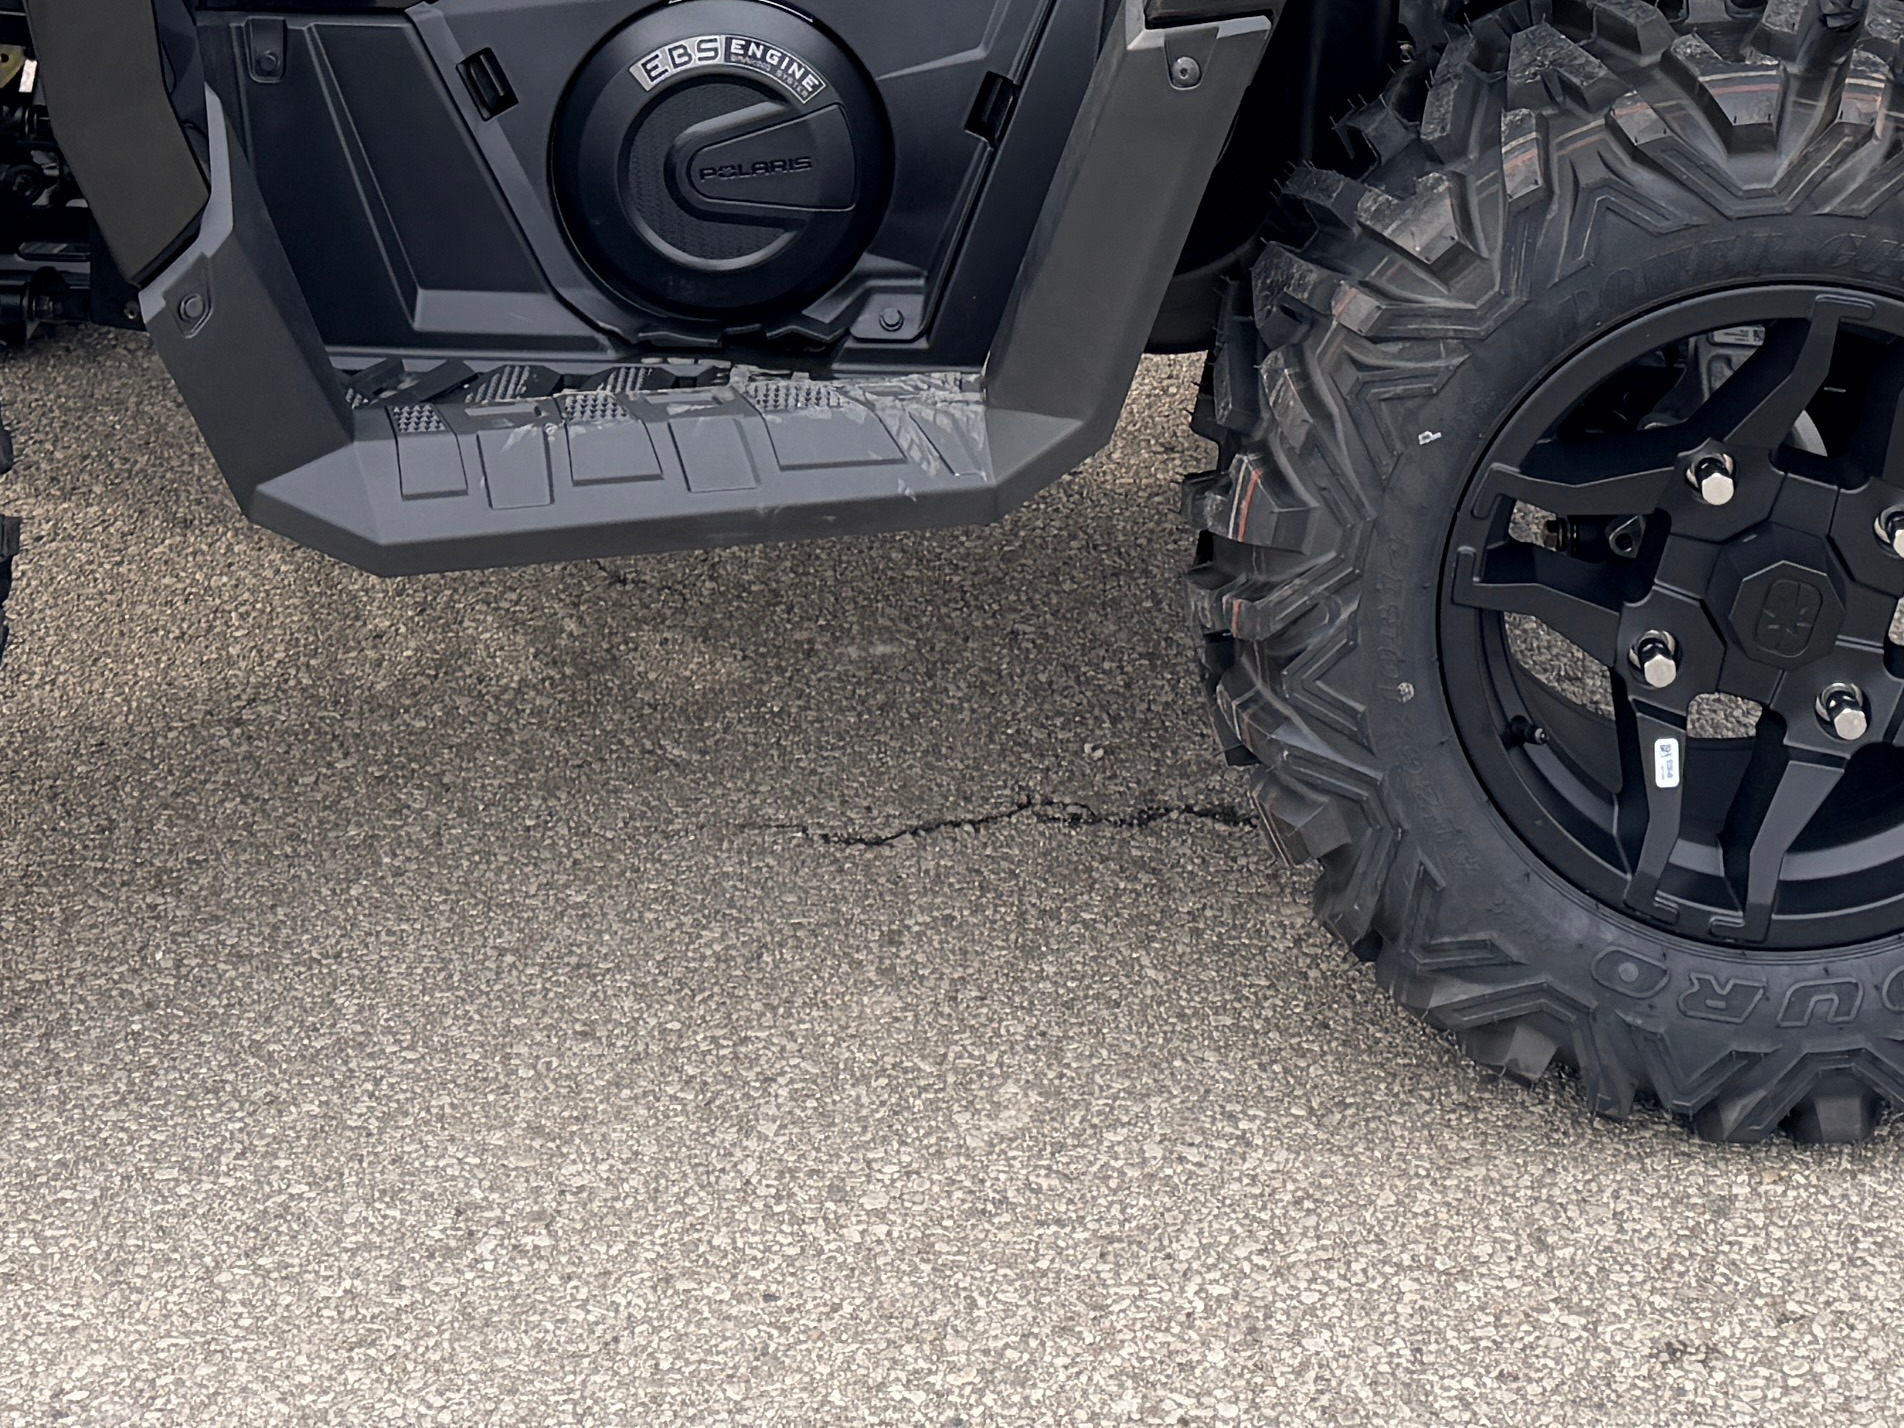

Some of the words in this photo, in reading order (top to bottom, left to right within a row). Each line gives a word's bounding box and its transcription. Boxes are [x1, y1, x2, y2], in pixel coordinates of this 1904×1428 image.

[641, 37, 720, 83] EBS
[730, 38, 819, 93] ENGINE
[699, 156, 813, 182] POLARIS
